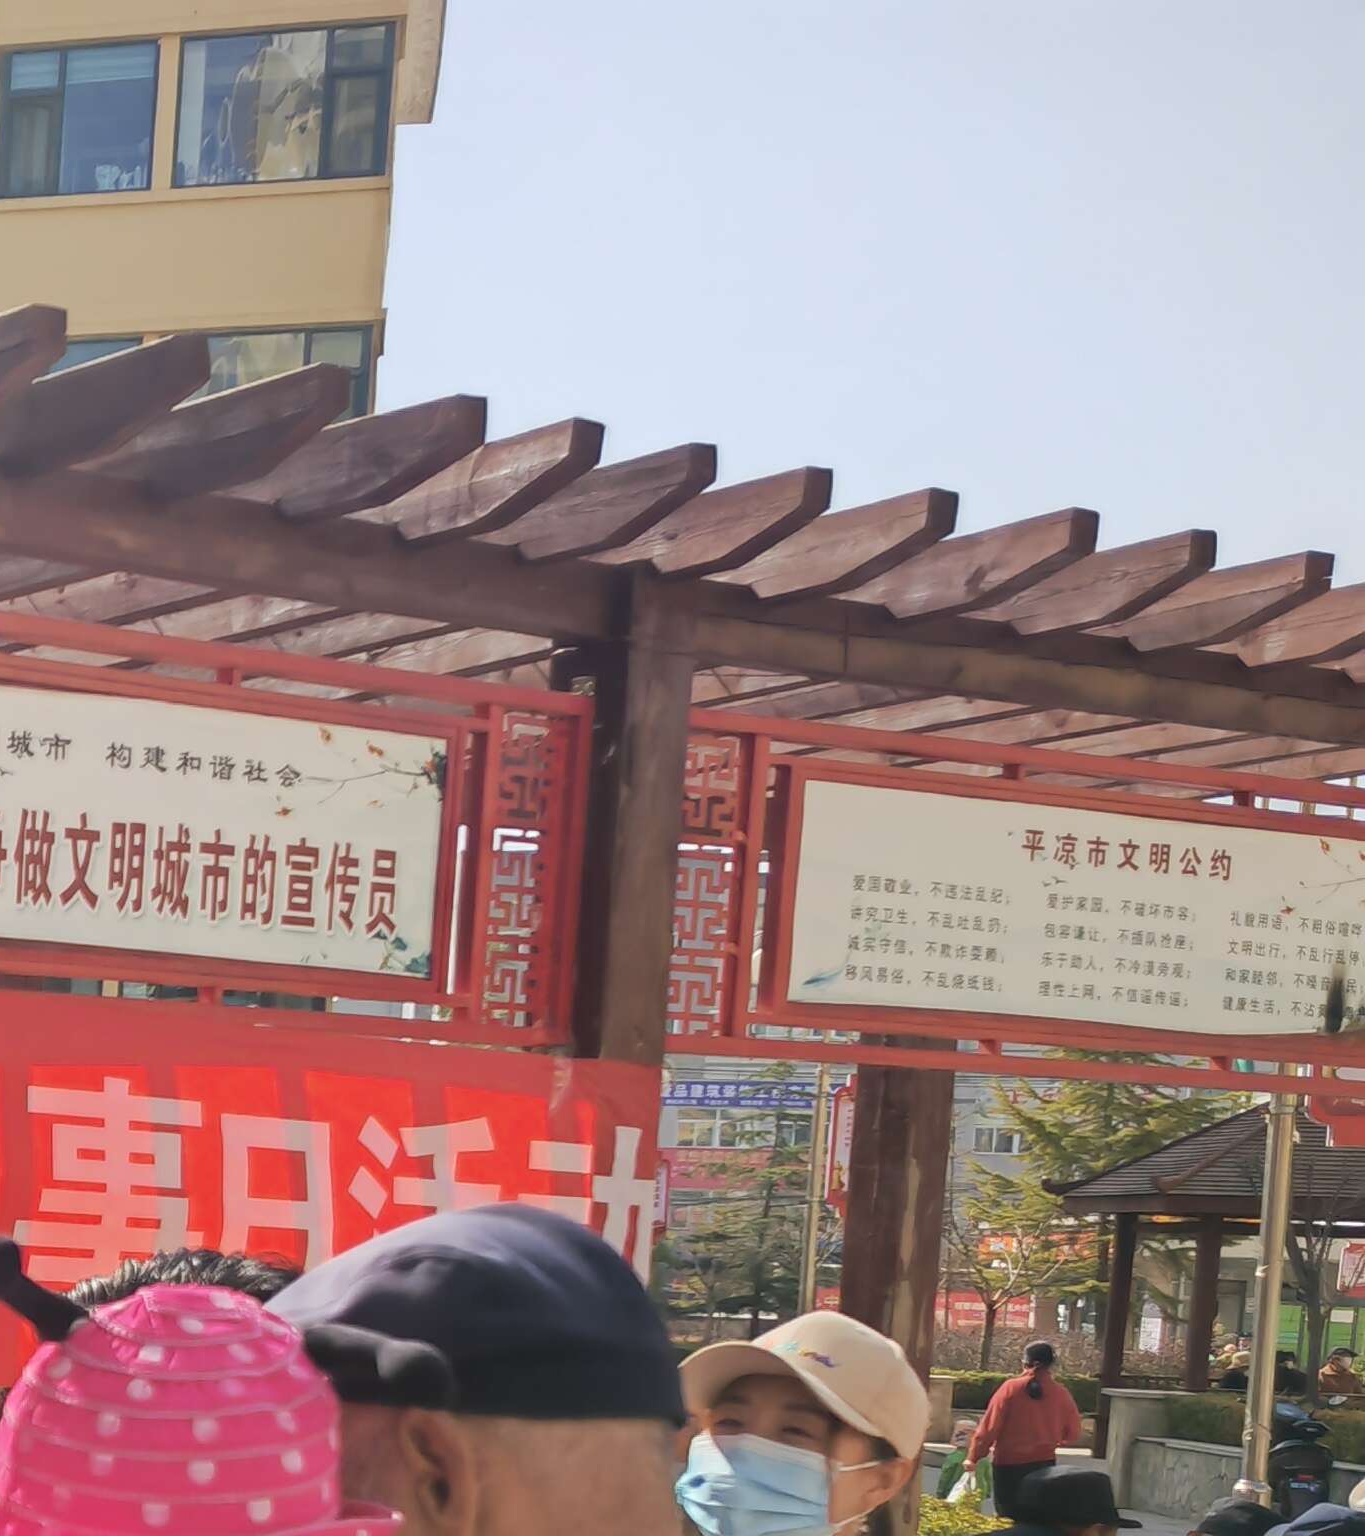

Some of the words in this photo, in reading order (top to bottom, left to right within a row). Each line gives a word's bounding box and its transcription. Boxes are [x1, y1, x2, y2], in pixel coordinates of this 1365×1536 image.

[1021, 828, 1233, 881] 平凉市文明公约
